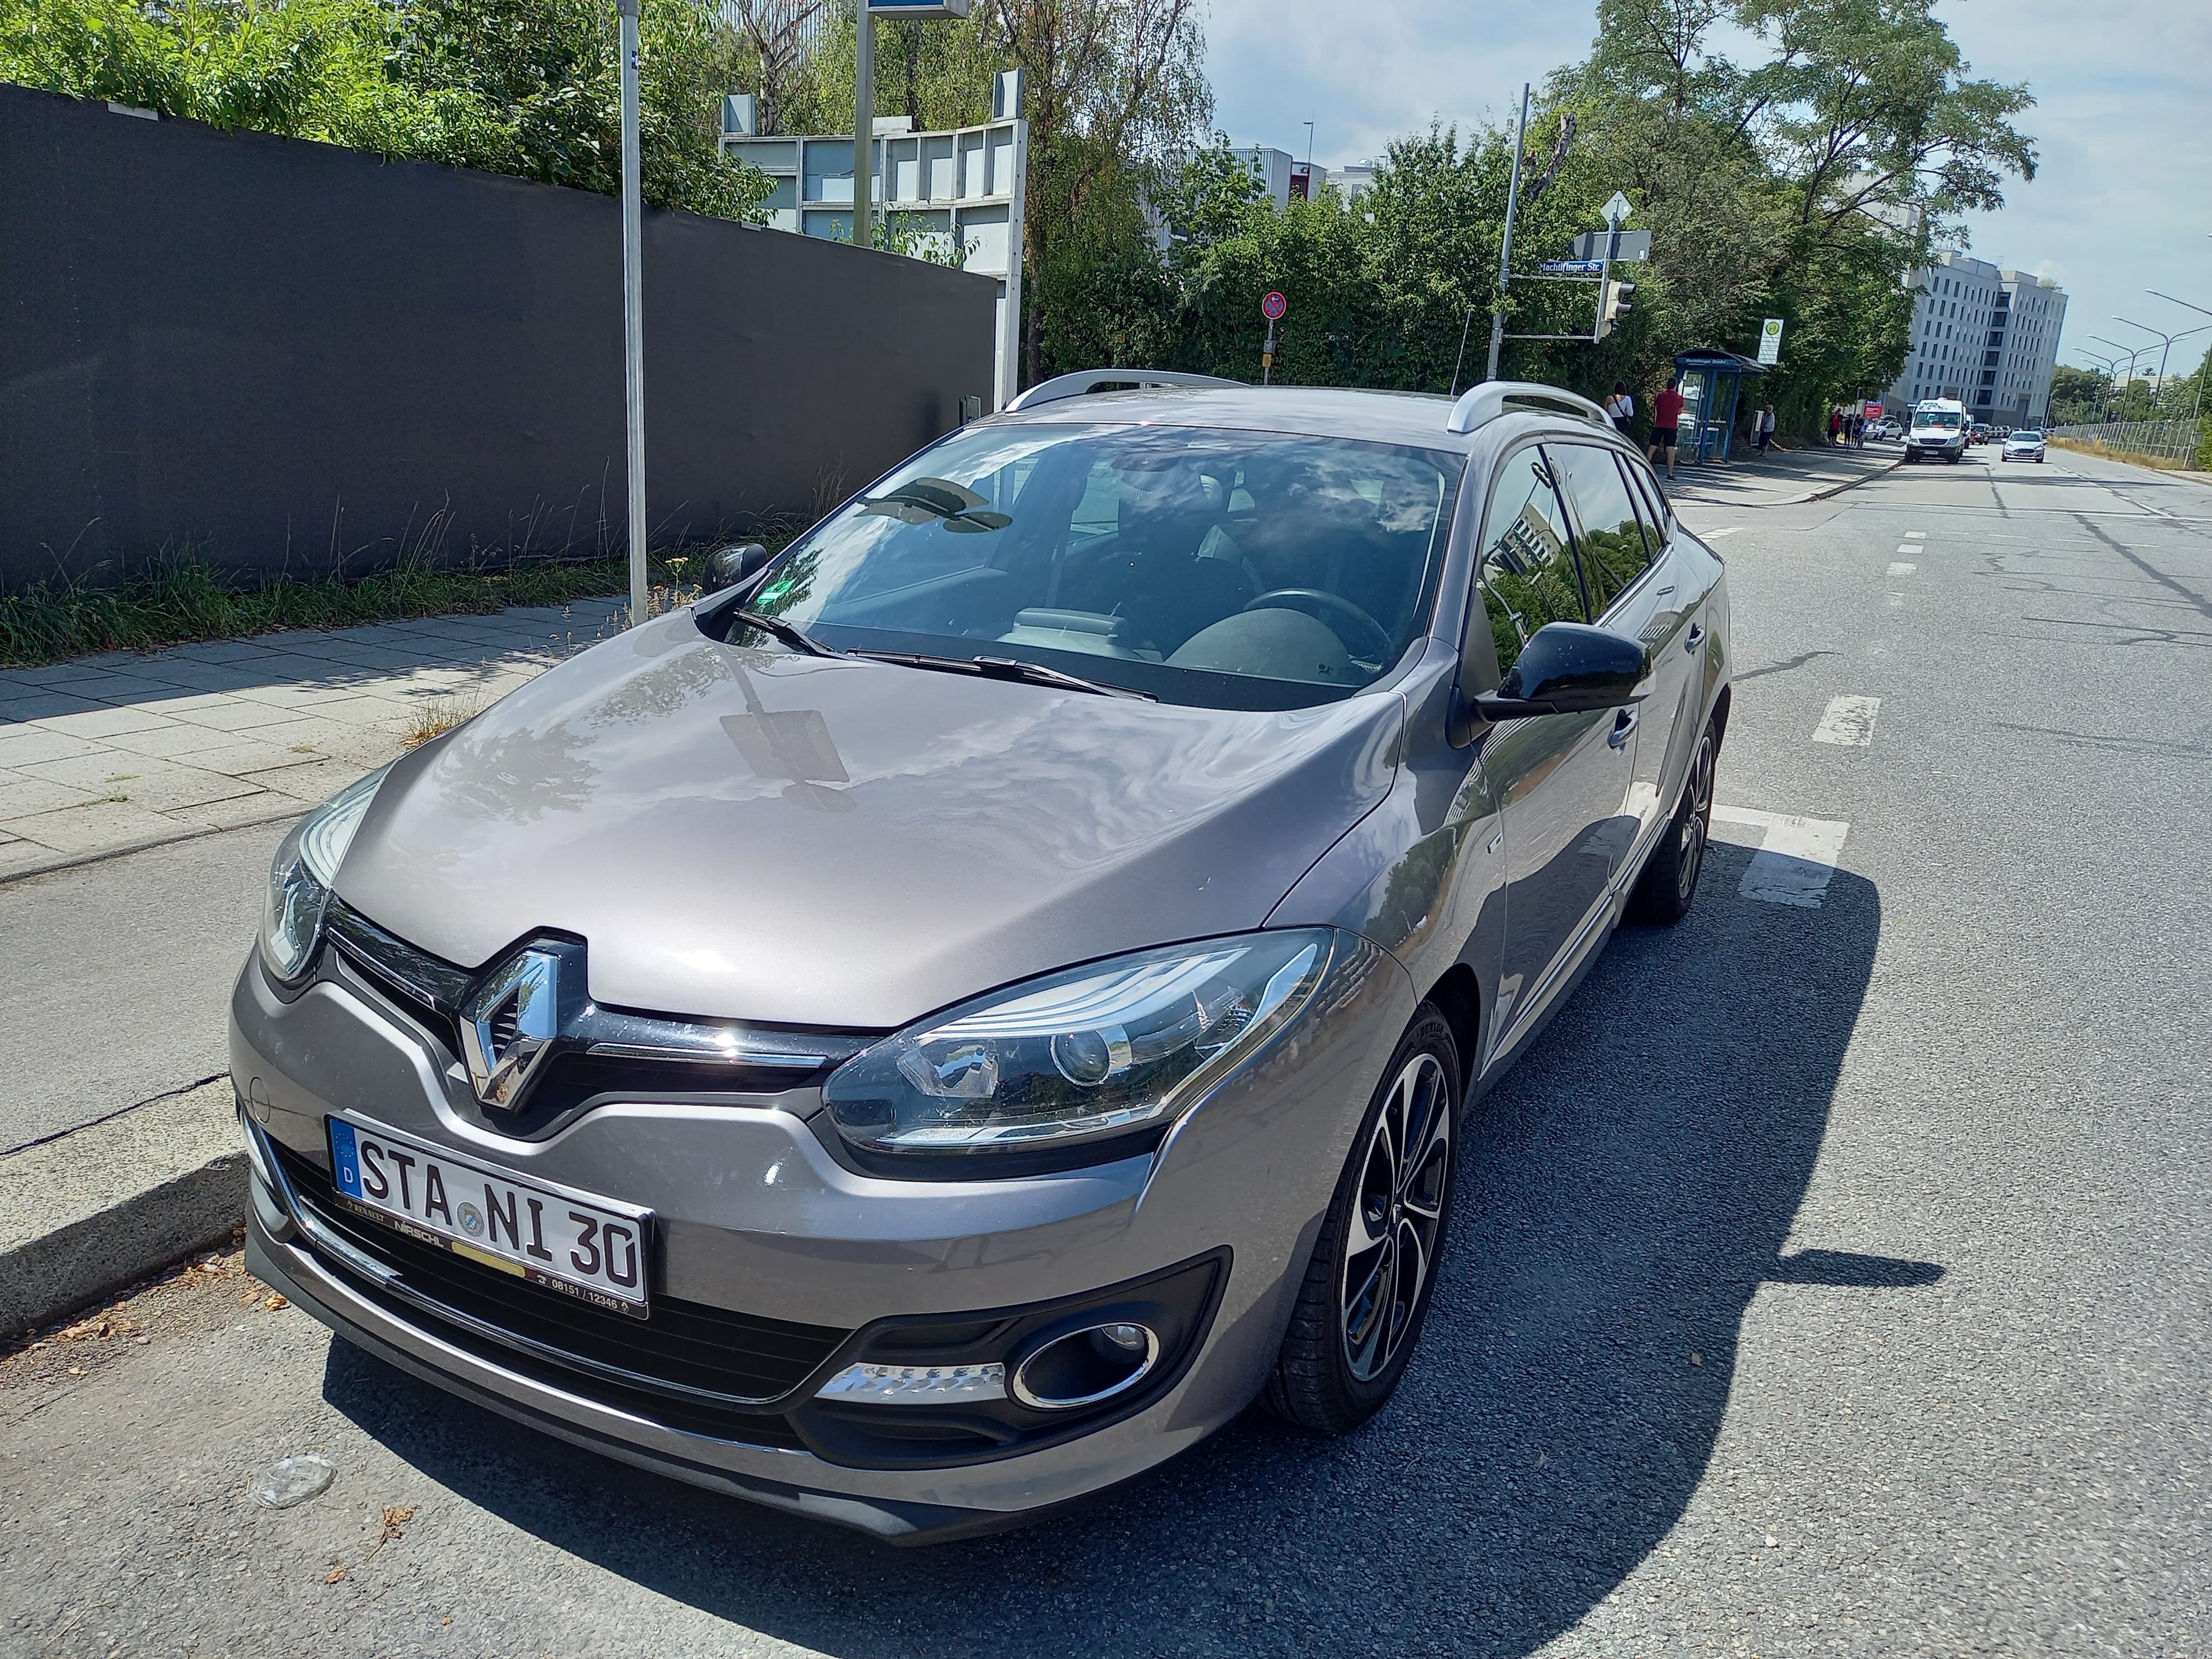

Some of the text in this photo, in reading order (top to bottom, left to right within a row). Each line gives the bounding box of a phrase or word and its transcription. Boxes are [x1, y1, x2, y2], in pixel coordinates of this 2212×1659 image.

[1587, 262, 1600, 272] Str.
[343, 1166, 353, 1183] D
[354, 1204, 385, 1222] RENAULT
[361, 1140, 452, 1226] STA
[484, 1183, 552, 1261] NI
[568, 1211, 637, 1288] 30
[551, 1279, 580, 1296] 08151
[588, 1292, 618, 1309] 12346
